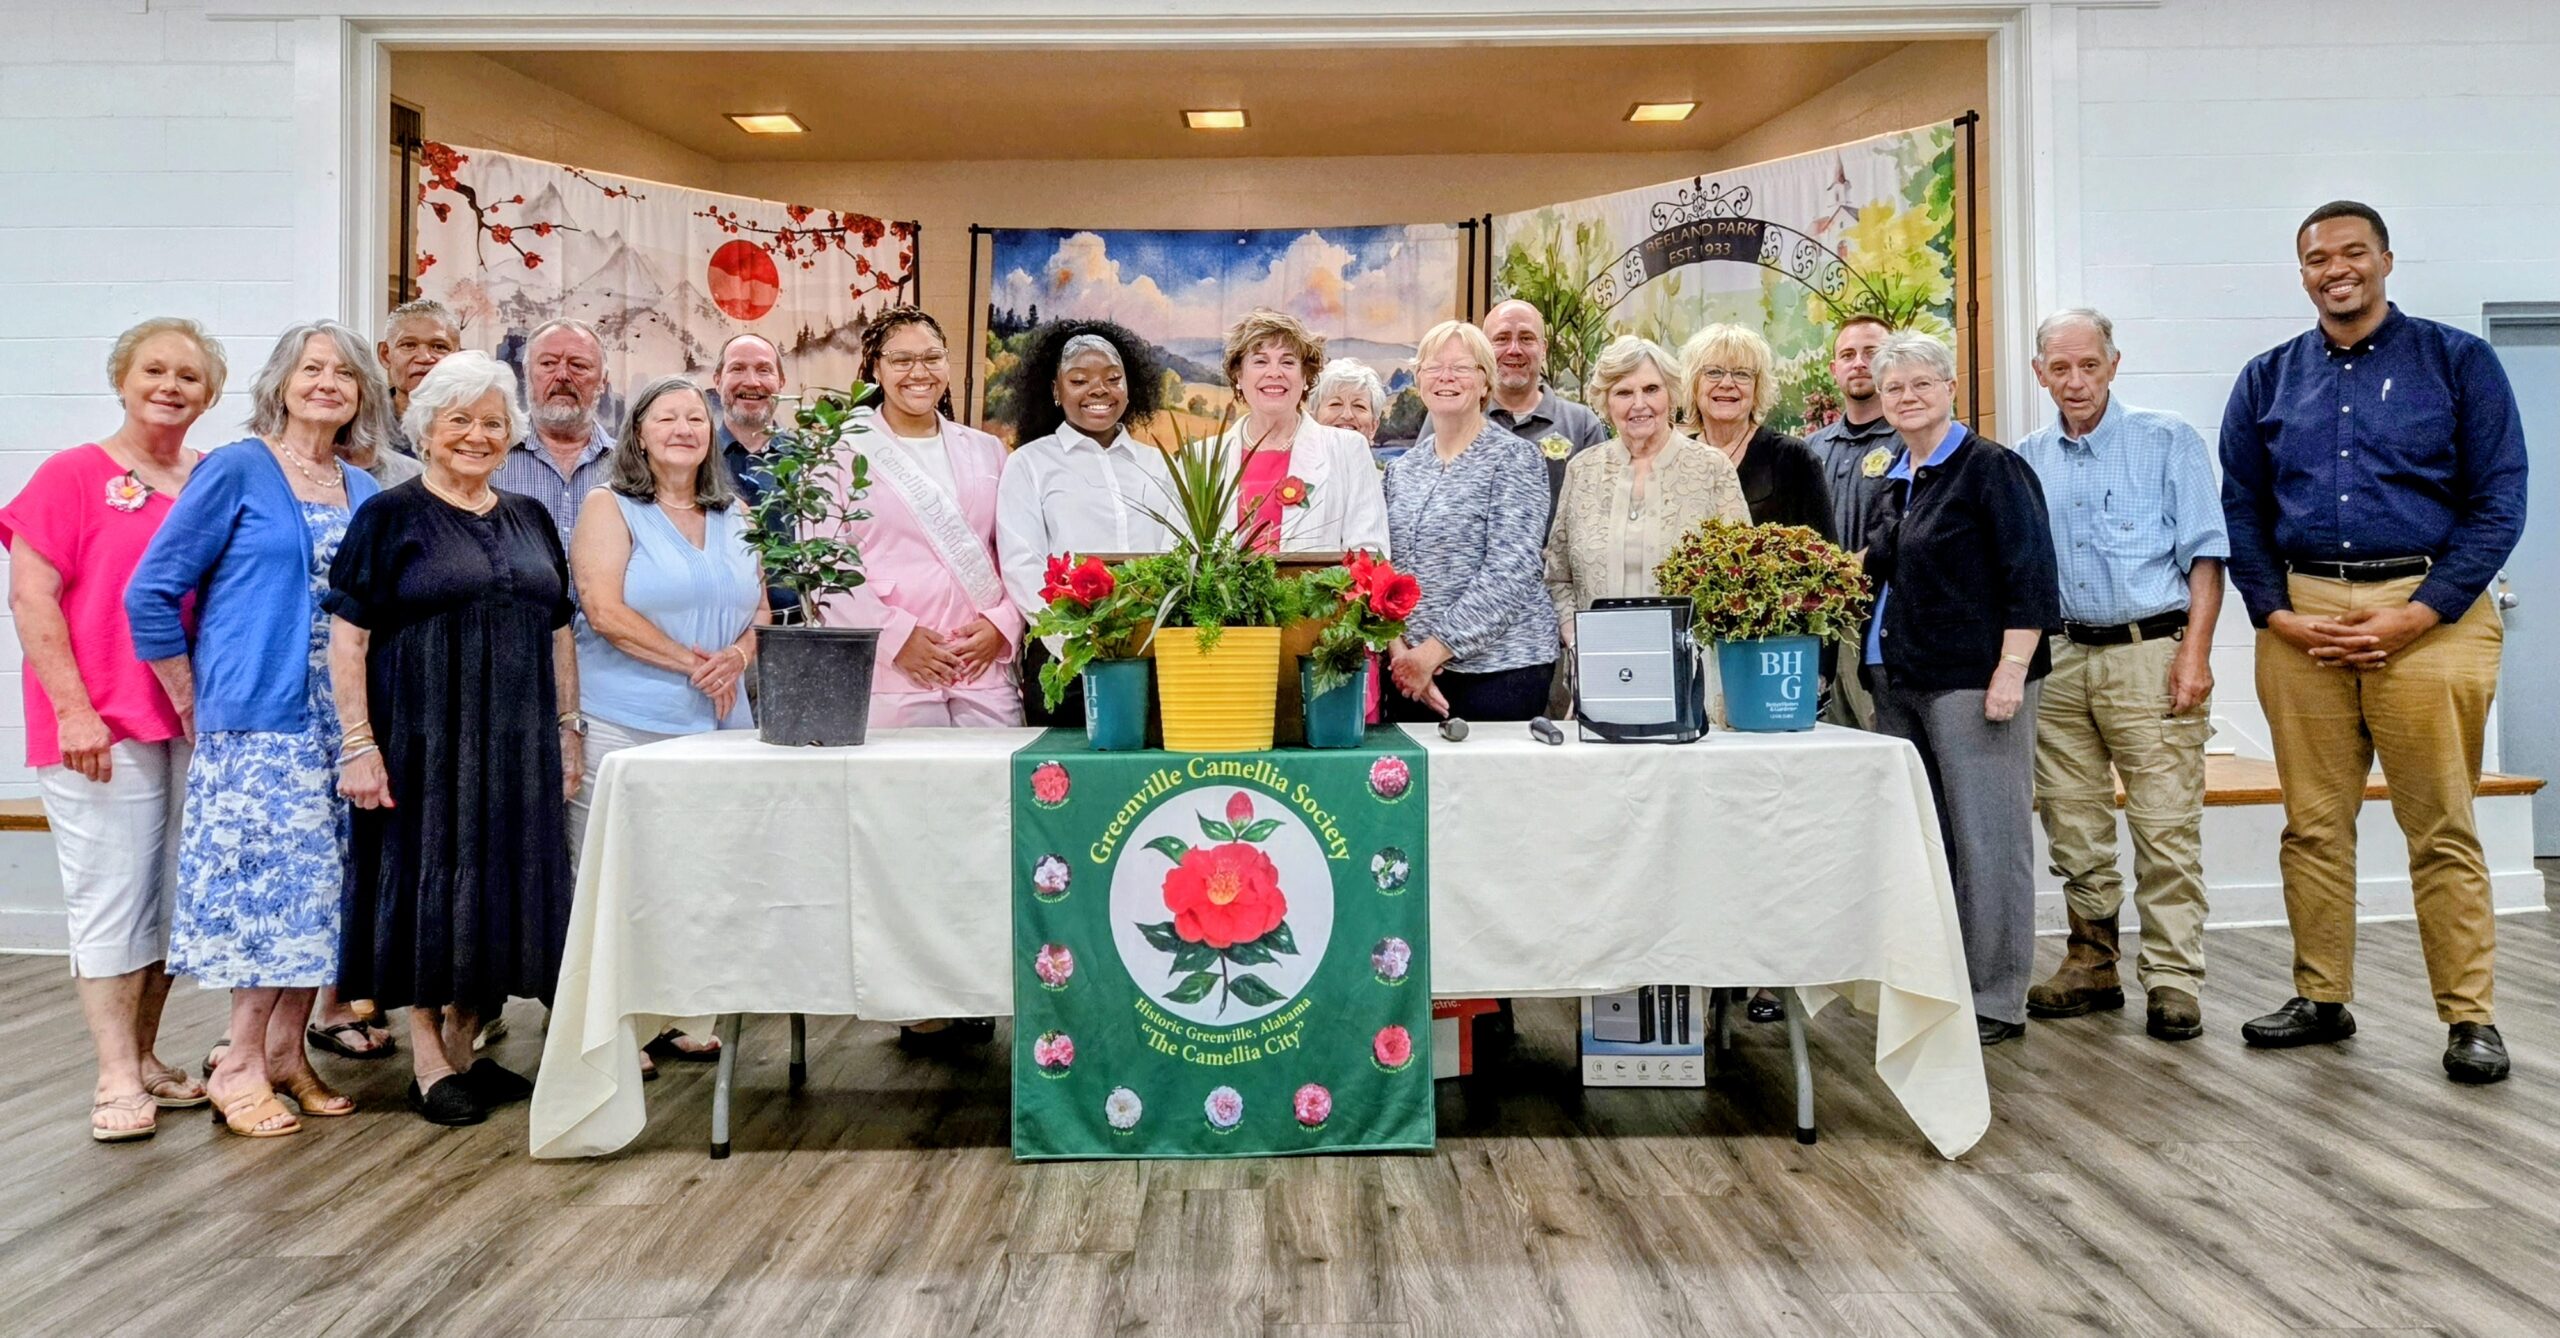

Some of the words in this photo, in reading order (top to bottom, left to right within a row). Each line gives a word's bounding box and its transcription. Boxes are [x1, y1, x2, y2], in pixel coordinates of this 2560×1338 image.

[1717, 222, 1759, 237] PARK
[1669, 246, 1697, 265] EST.
[1699, 242, 1731, 256] 1933
[874, 446, 929, 502] Camellia
[1760, 651, 1803, 676] BH
[1780, 675, 1802, 700] G
[1090, 768, 1183, 864] Greenville
[1187, 757, 1289, 793] Camellia
[1291, 783, 1350, 860] Society
[1134, 997, 1184, 1035] Historic
[1185, 1026, 1257, 1044] Greenville,
[1260, 997, 1312, 1035] Alabama
[1141, 1022, 1178, 1056] “The
[1182, 1044, 1262, 1066] Camellia
[1264, 1020, 1304, 1055] City”
